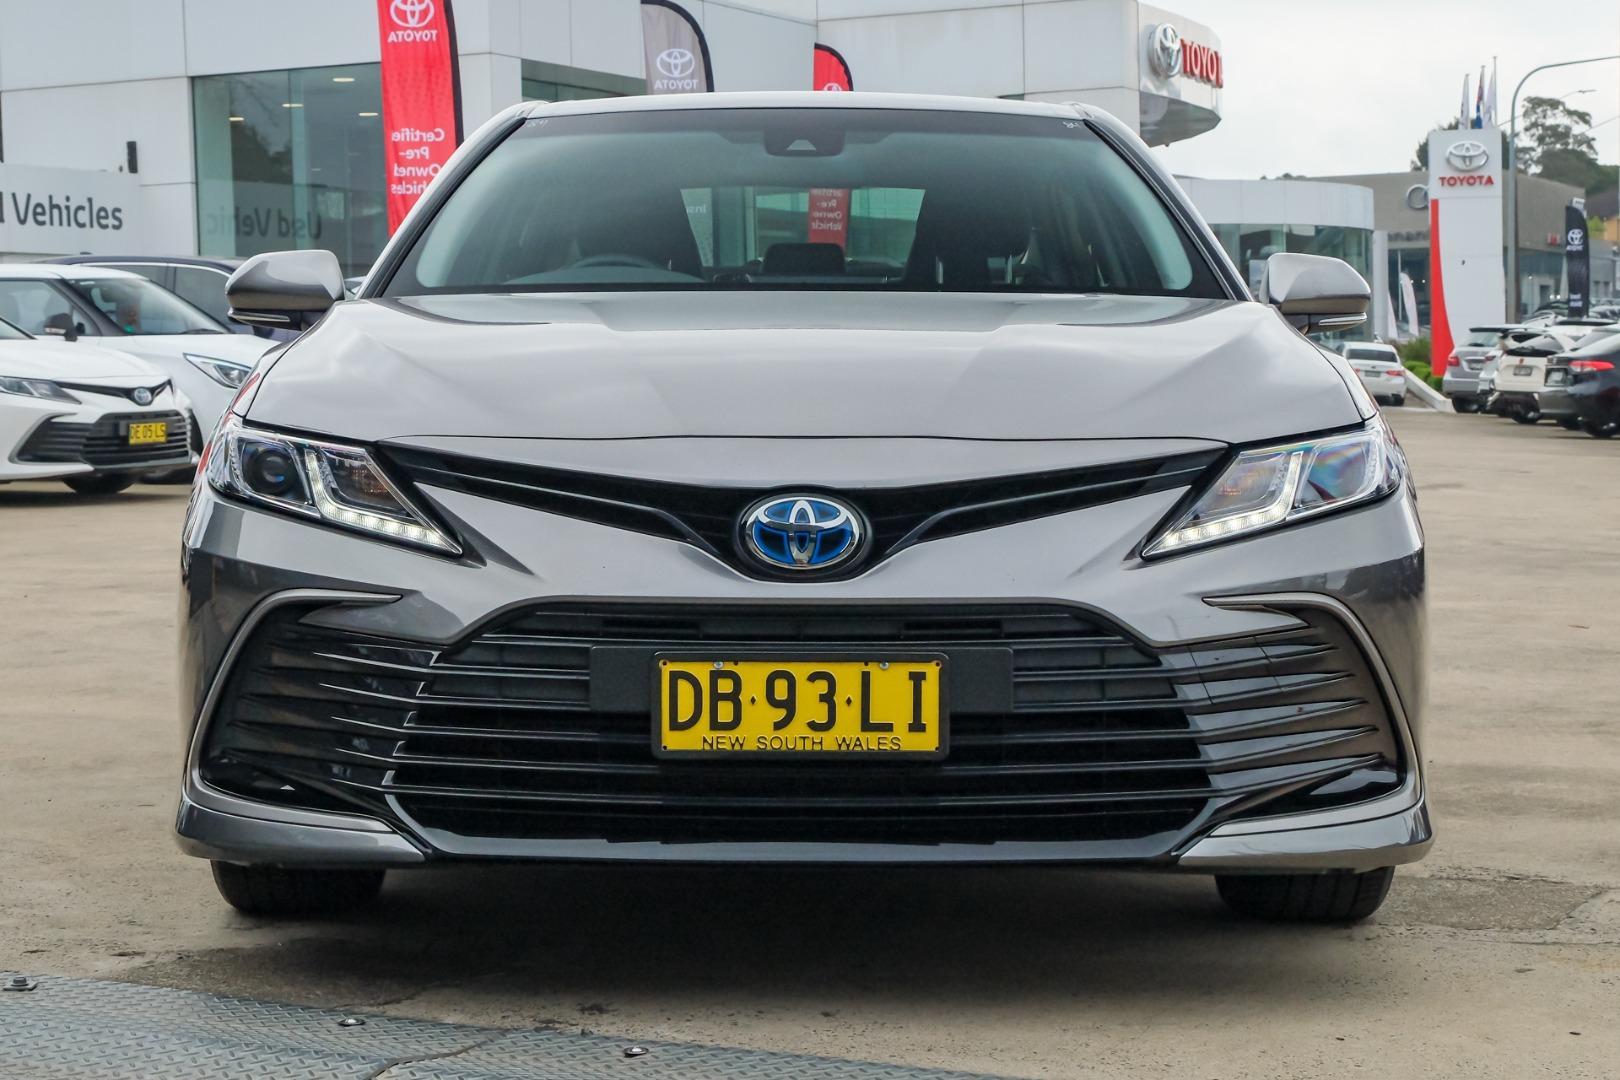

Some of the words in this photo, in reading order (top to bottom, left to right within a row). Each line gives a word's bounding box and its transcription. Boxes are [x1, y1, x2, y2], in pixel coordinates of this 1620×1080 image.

[1438, 175, 1494, 187] TOYOTA
[11, 191, 123, 231] Vehicles
[702, 735, 746, 751] NEW
[756, 735, 823, 751] SOUTH
[835, 736, 902, 751] WALES
